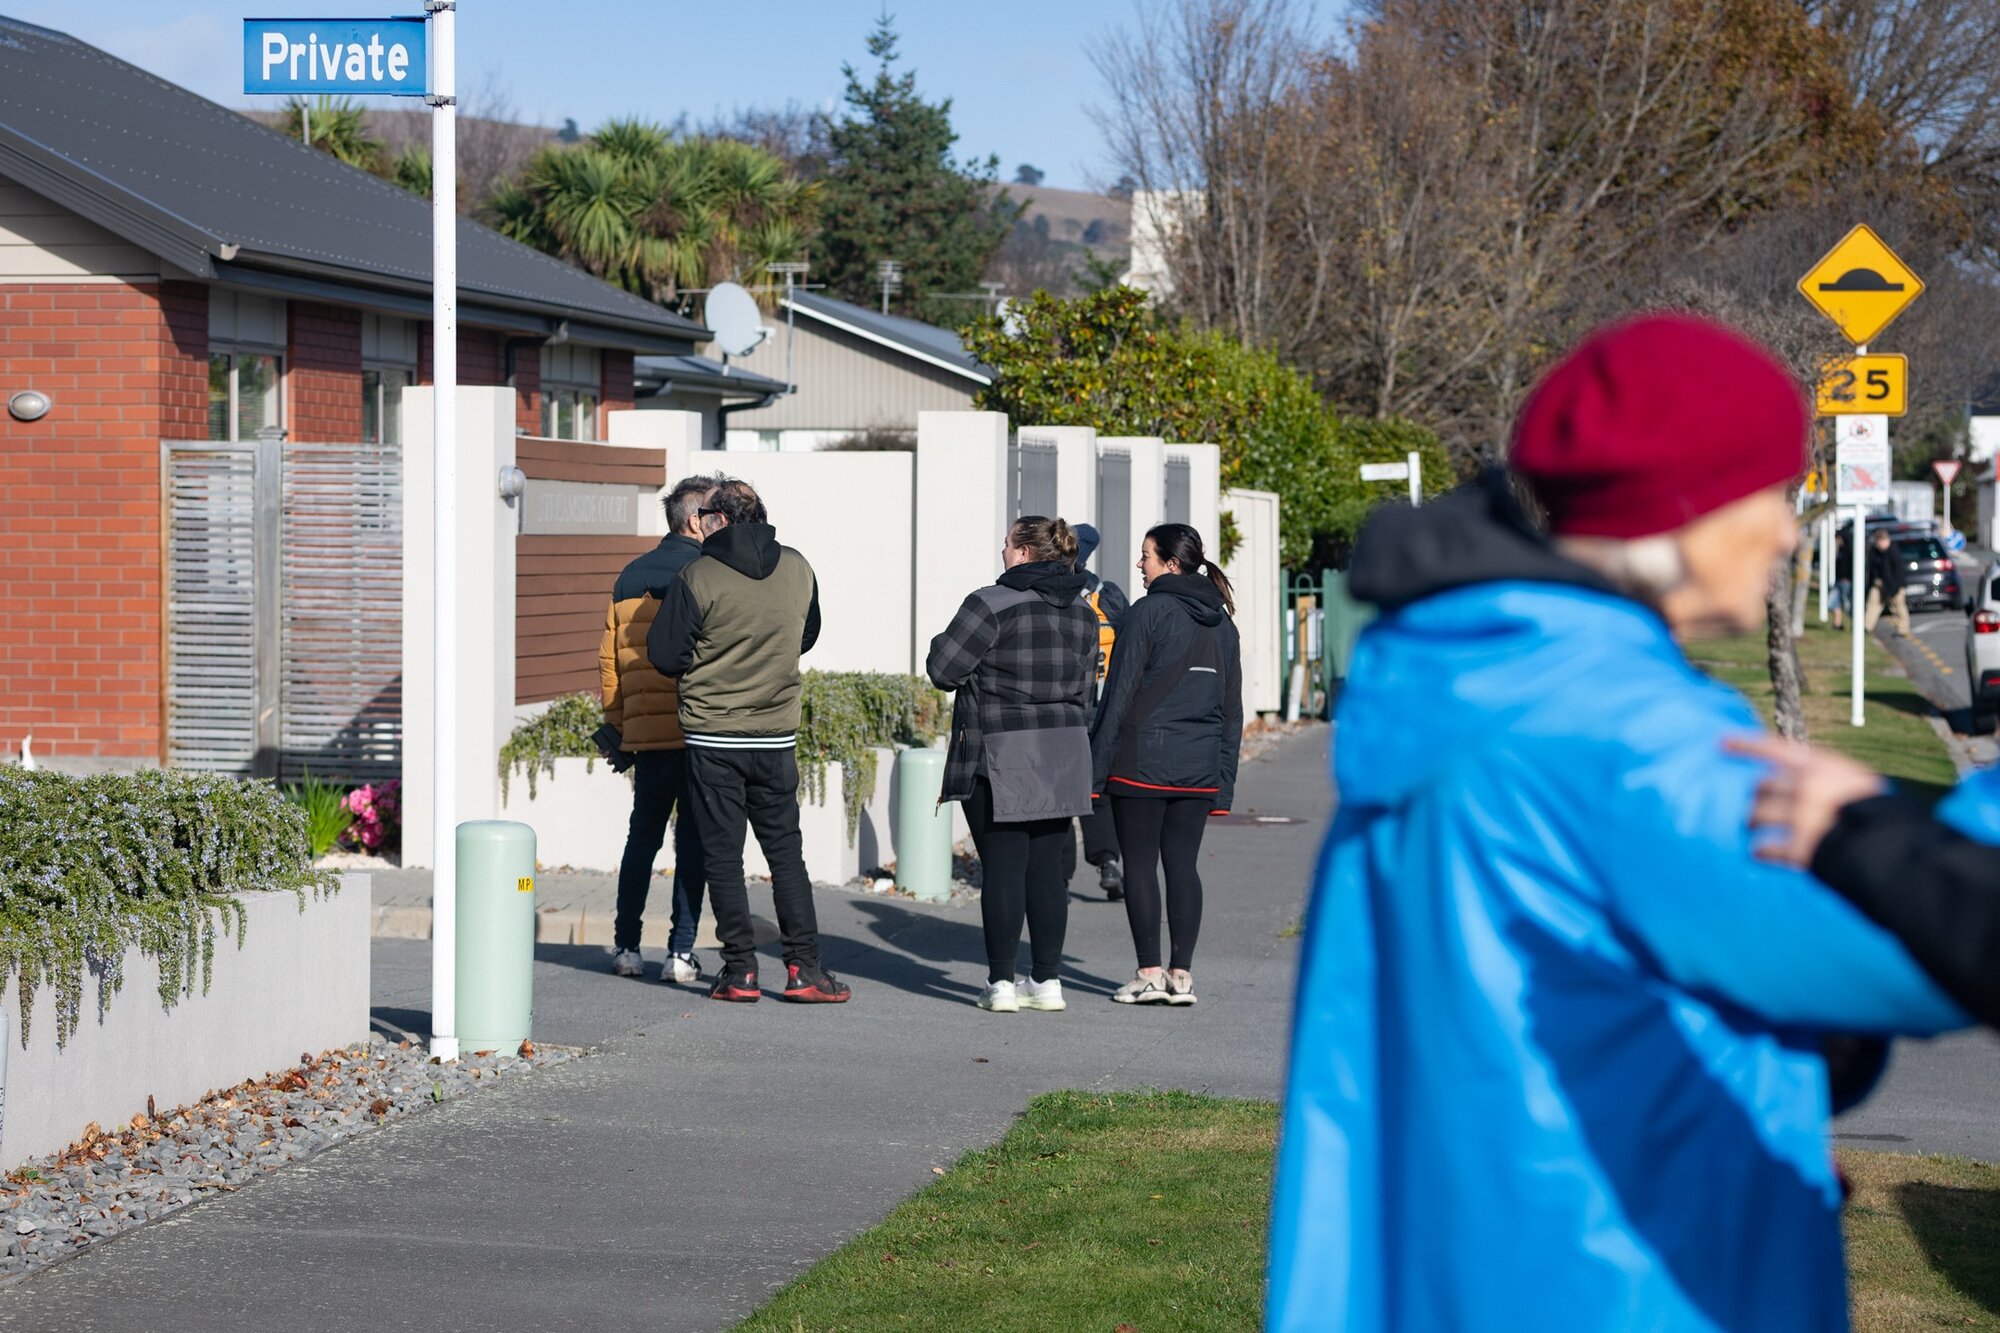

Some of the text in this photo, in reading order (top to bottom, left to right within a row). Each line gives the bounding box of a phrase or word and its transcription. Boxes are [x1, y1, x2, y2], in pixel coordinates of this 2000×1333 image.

[262, 32, 409, 81] Private
[1831, 369, 1890, 401] 25
[598, 494, 629, 523] COURT
[518, 878, 531, 891] MP
